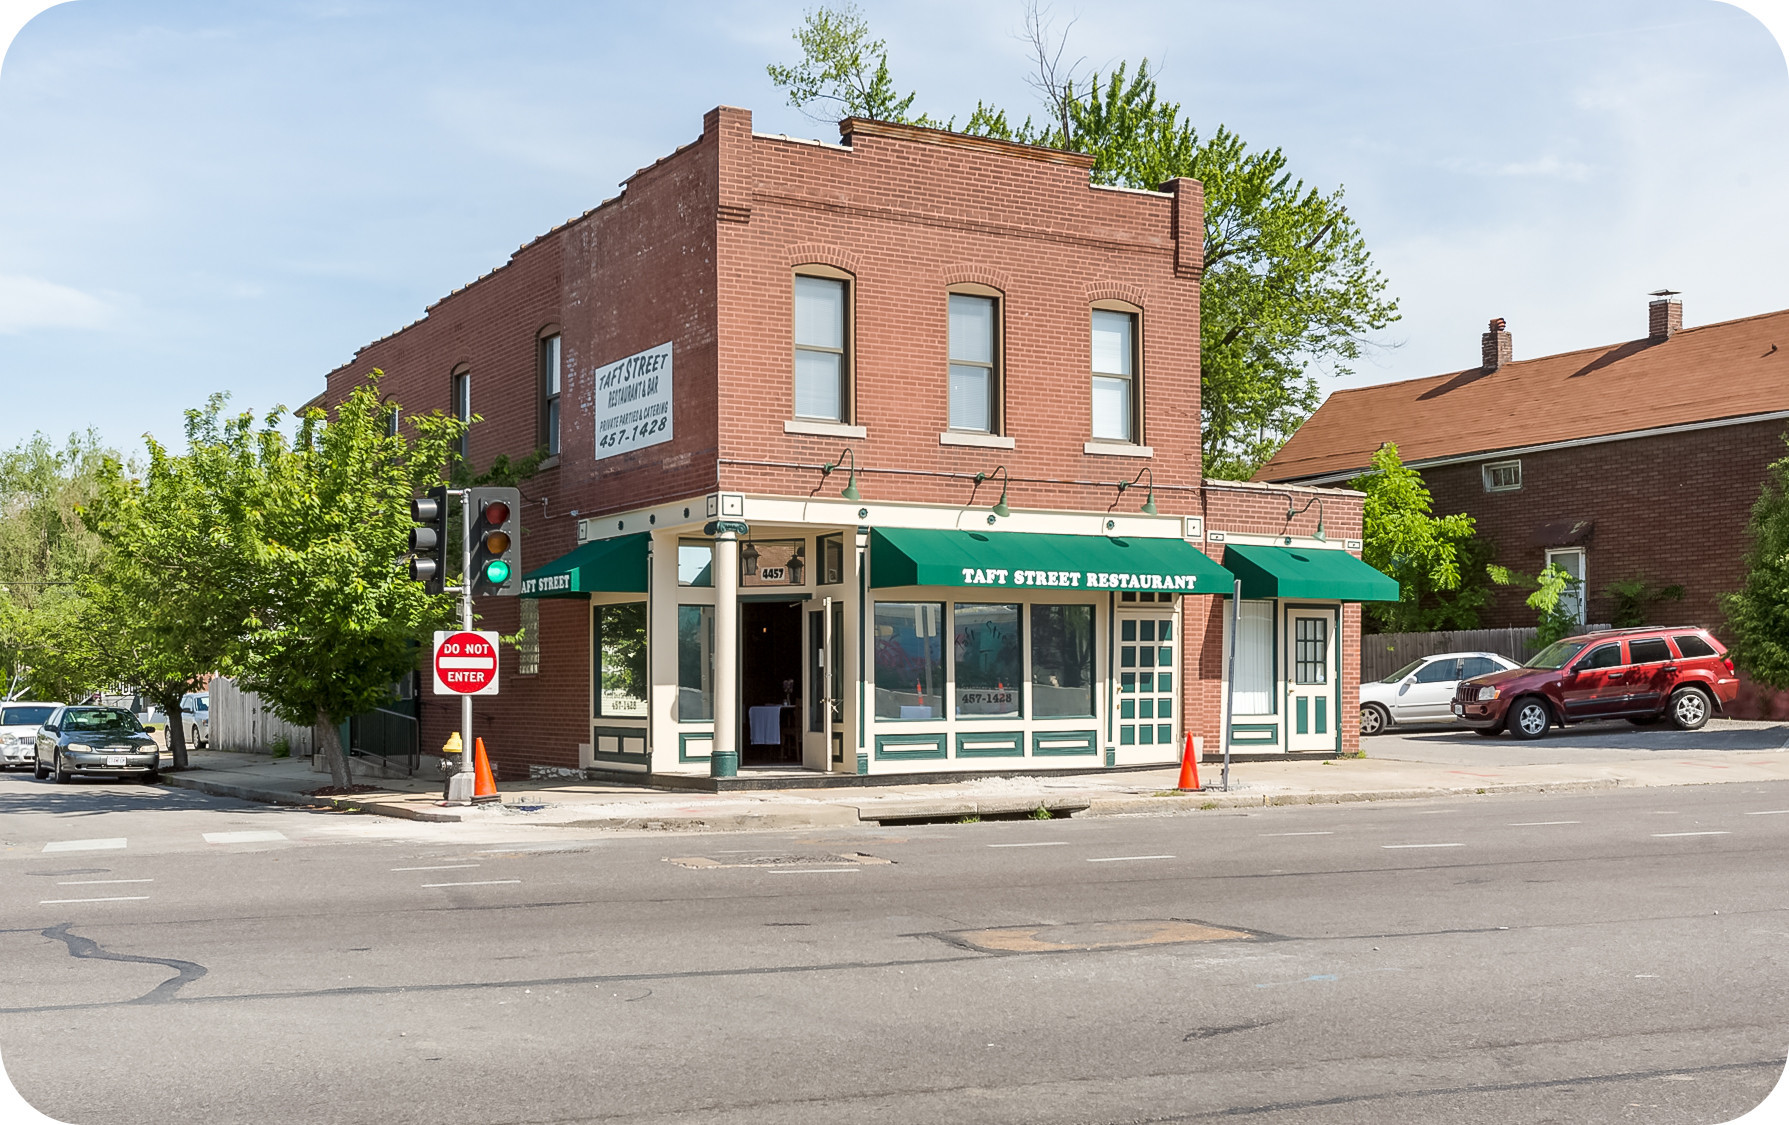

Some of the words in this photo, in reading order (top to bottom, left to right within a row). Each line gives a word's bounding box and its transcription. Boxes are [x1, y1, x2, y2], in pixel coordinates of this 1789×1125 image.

[599, 362, 625, 391] TAFT
[624, 353, 668, 382] STREET
[608, 381, 642, 409] RESTAURANT
[647, 375, 659, 396] BAR
[600, 415, 620, 433] PRIVATE
[619, 409, 640, 427] PARTIES
[643, 401, 668, 420] CATERING
[599, 416, 667, 448] 457-1428
[521, 579, 537, 593] AFT
[538, 574, 570, 592] STREET
[763, 568, 784, 579] 4457
[962, 568, 1008, 585] TAFT
[1013, 570, 1081, 587] STREET
[1086, 572, 1197, 589] RESTAURANT
[444, 643, 460, 655] DO
[465, 643, 489, 655] NOT
[447, 671, 485, 682] ENTER
[961, 693, 1012, 704] 457-1428
